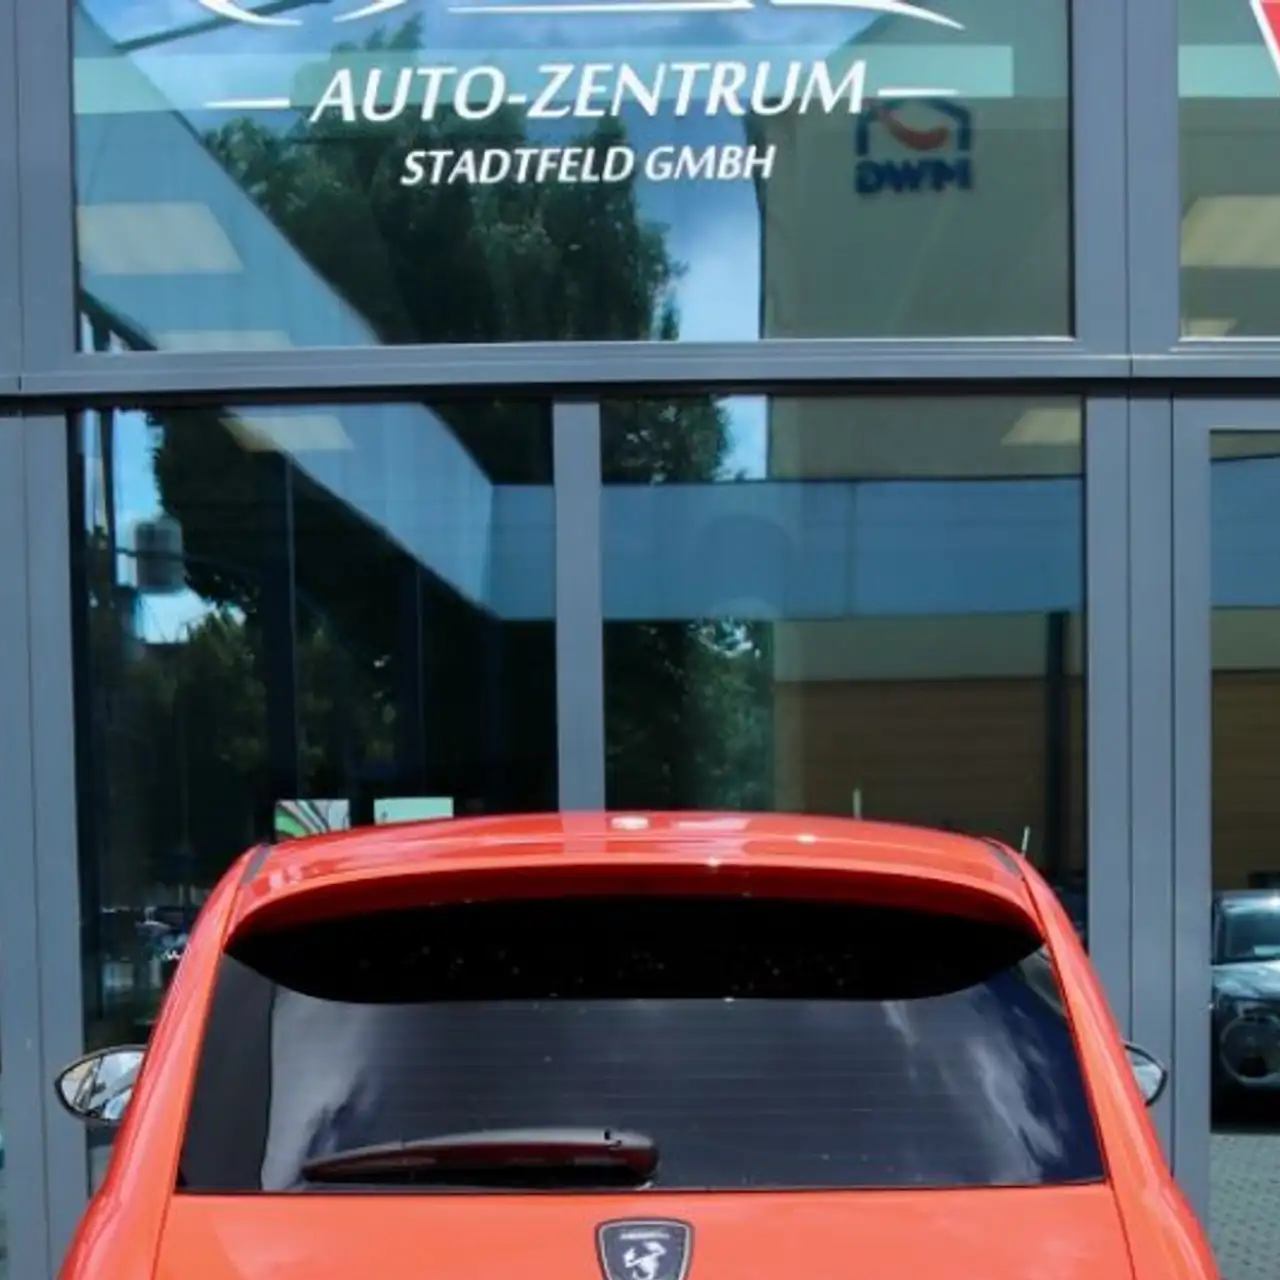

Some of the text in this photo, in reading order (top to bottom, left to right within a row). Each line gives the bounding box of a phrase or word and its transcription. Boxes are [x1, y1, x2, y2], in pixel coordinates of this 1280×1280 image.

[311, 60, 867, 122] AUTO-ZENTRUM
[401, 144, 777, 186] STADTFELD GMBH
